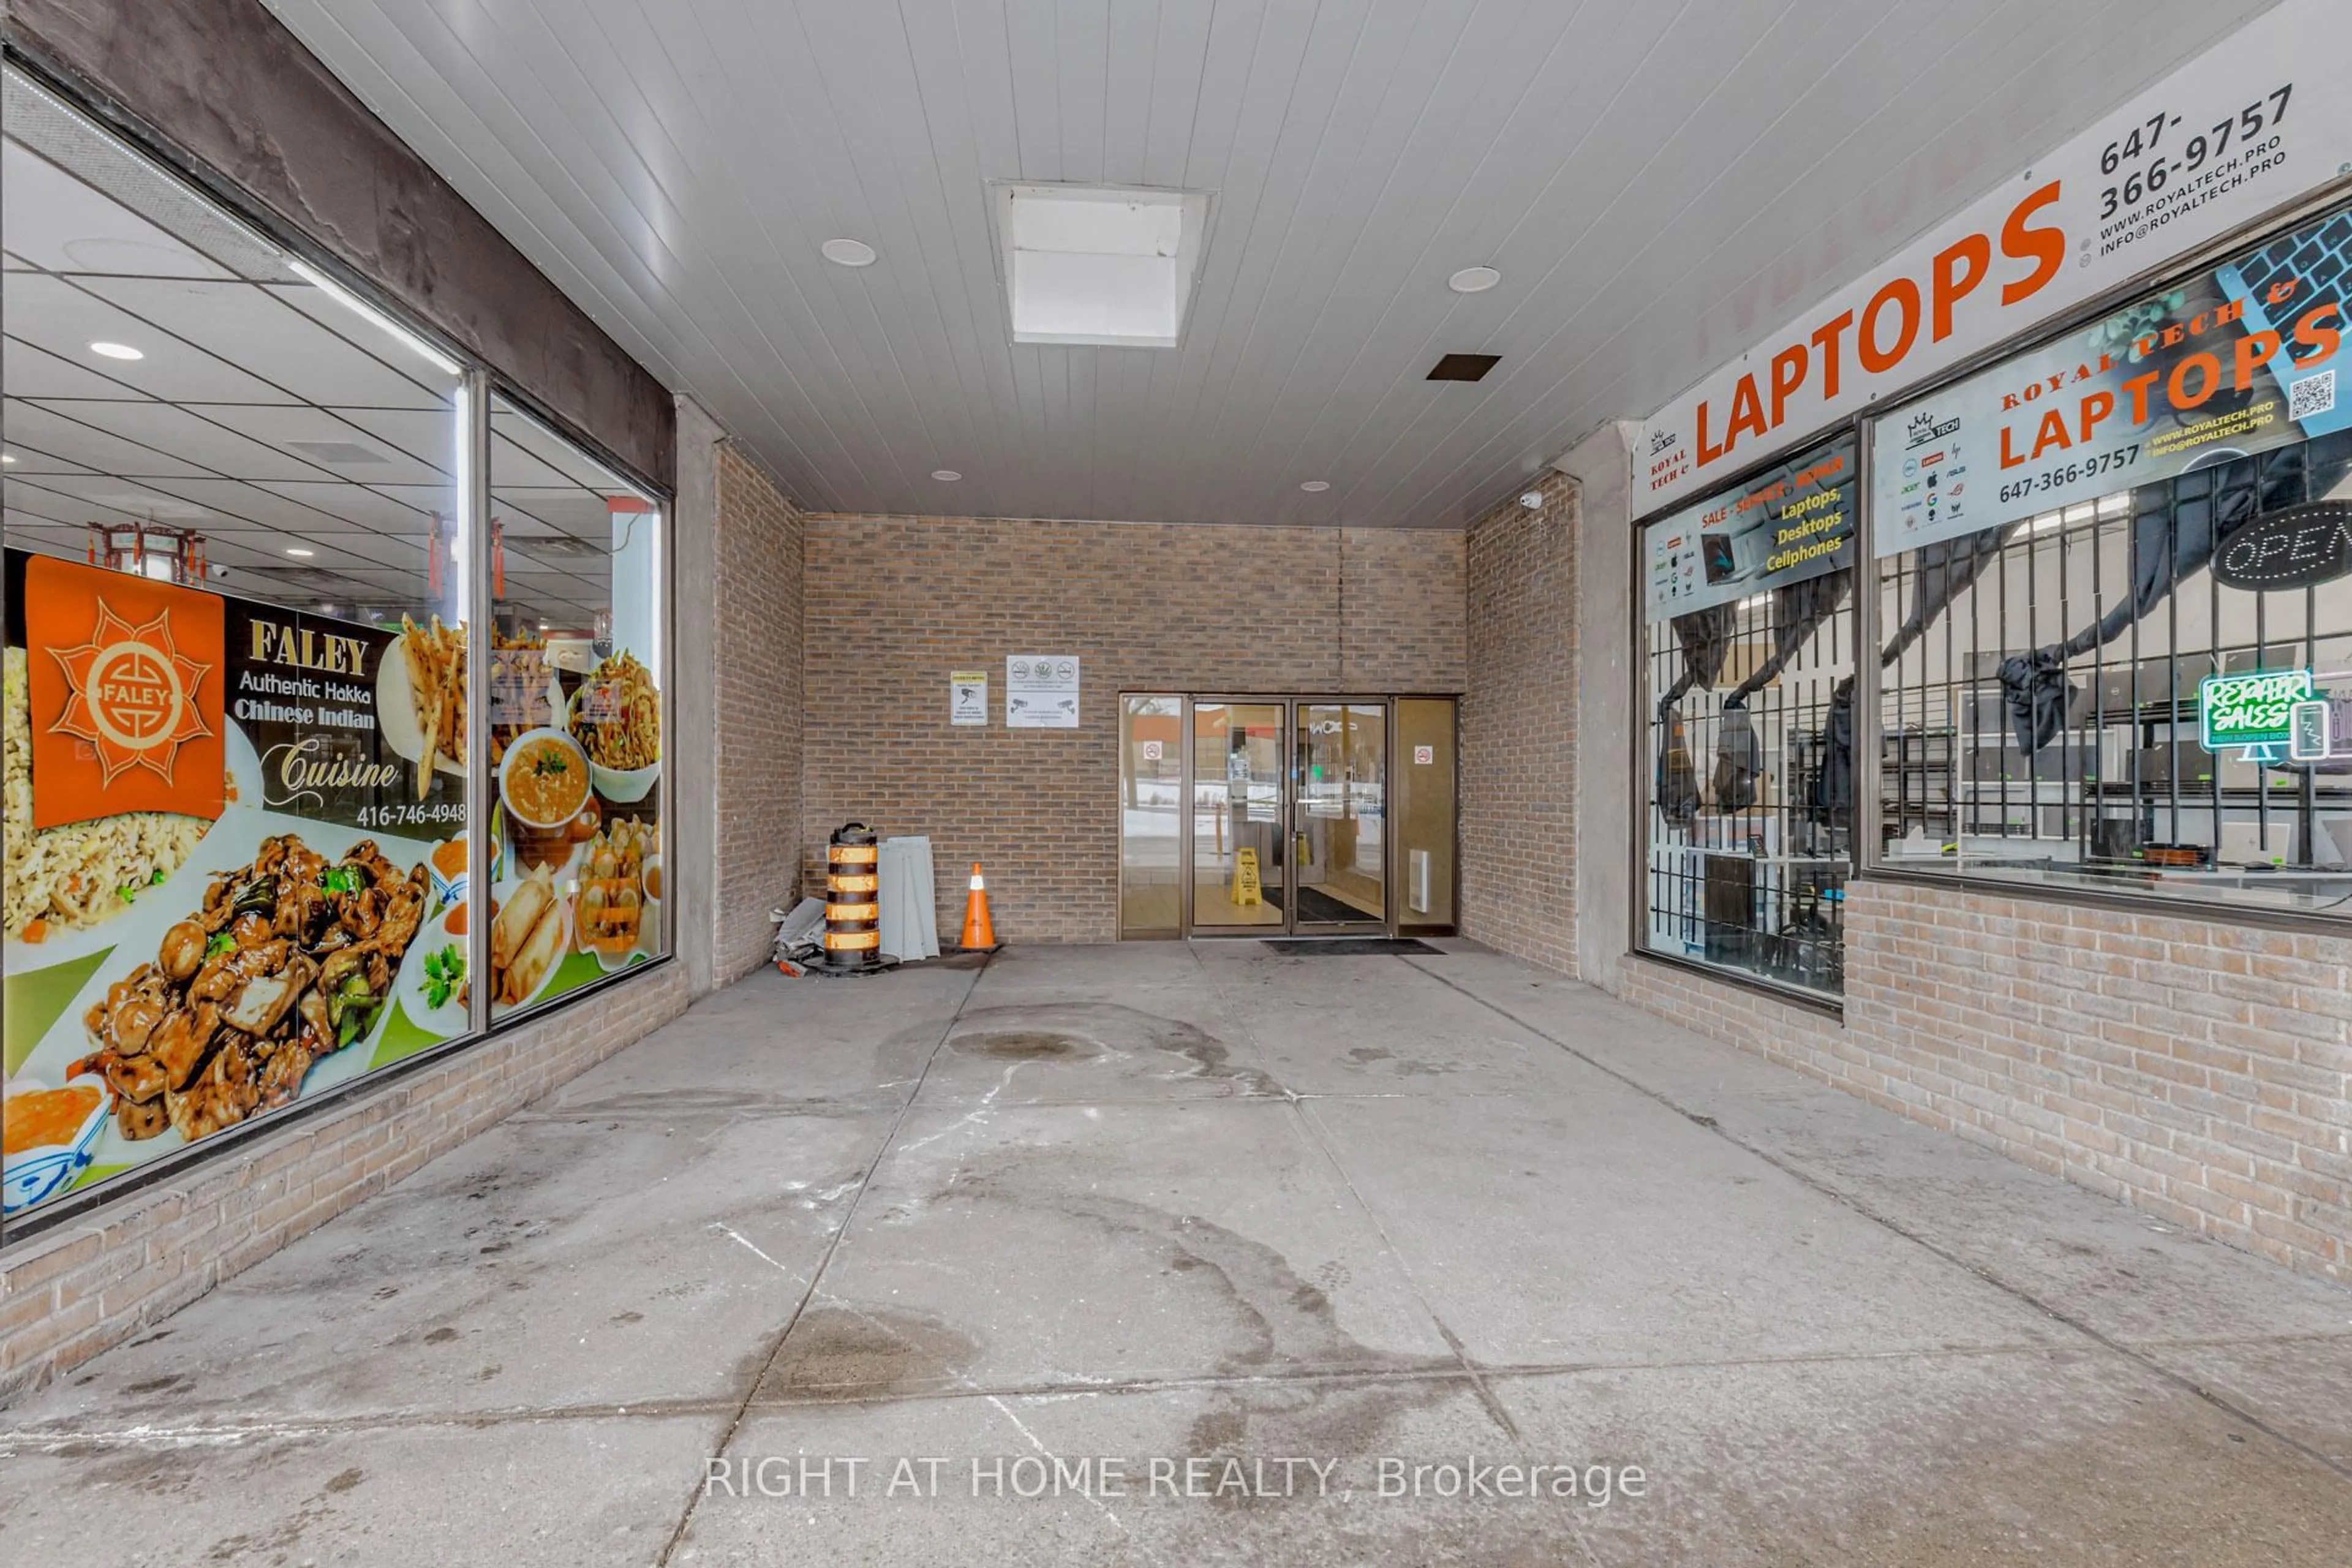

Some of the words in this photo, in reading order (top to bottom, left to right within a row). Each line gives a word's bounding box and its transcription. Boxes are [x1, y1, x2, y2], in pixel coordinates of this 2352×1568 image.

[2100, 111, 2182, 175] 647-
[2100, 83, 2293, 221] 366-9757
[2100, 135, 2281, 240] WWW.ROYALTECH.PRO
[2100, 151, 2286, 257] INFO@ROYALTECH.PRO
[1697, 179, 2065, 469] LAPTOPS
[2001, 353, 2118, 412] ROYAL
[2133, 296, 2248, 359] TECH
[2000, 303, 2341, 470] LAPTOPS
[1937, 418, 1959, 436] TECH
[2151, 414, 2274, 457] INFO@ROYALTECH.PRO
[2152, 401, 2274, 445] WWW.ROYALTECH.PRO
[1649, 449, 1686, 476] ROYAL
[1649, 469, 1678, 491] TECH
[2000, 443, 2139, 503] 647-366-9757
[1702, 506, 1727, 529] SALE
[1781, 488, 1841, 521] Laptops,
[1777, 511, 1842, 545] Desktops
[1766, 536, 1842, 571] Cellphones
[249, 619, 369, 677] FALEY
[104, 683, 170, 706] FALEY
[239, 670, 321, 698] Authentic
[325, 682, 372, 704] Hakka
[234, 698, 314, 725] Chinese
[318, 707, 375, 729] Indian
[2211, 703, 2290, 731] SALES
[262, 739, 399, 795] Cuisine
[356, 803, 467, 827] 416-746-4948
